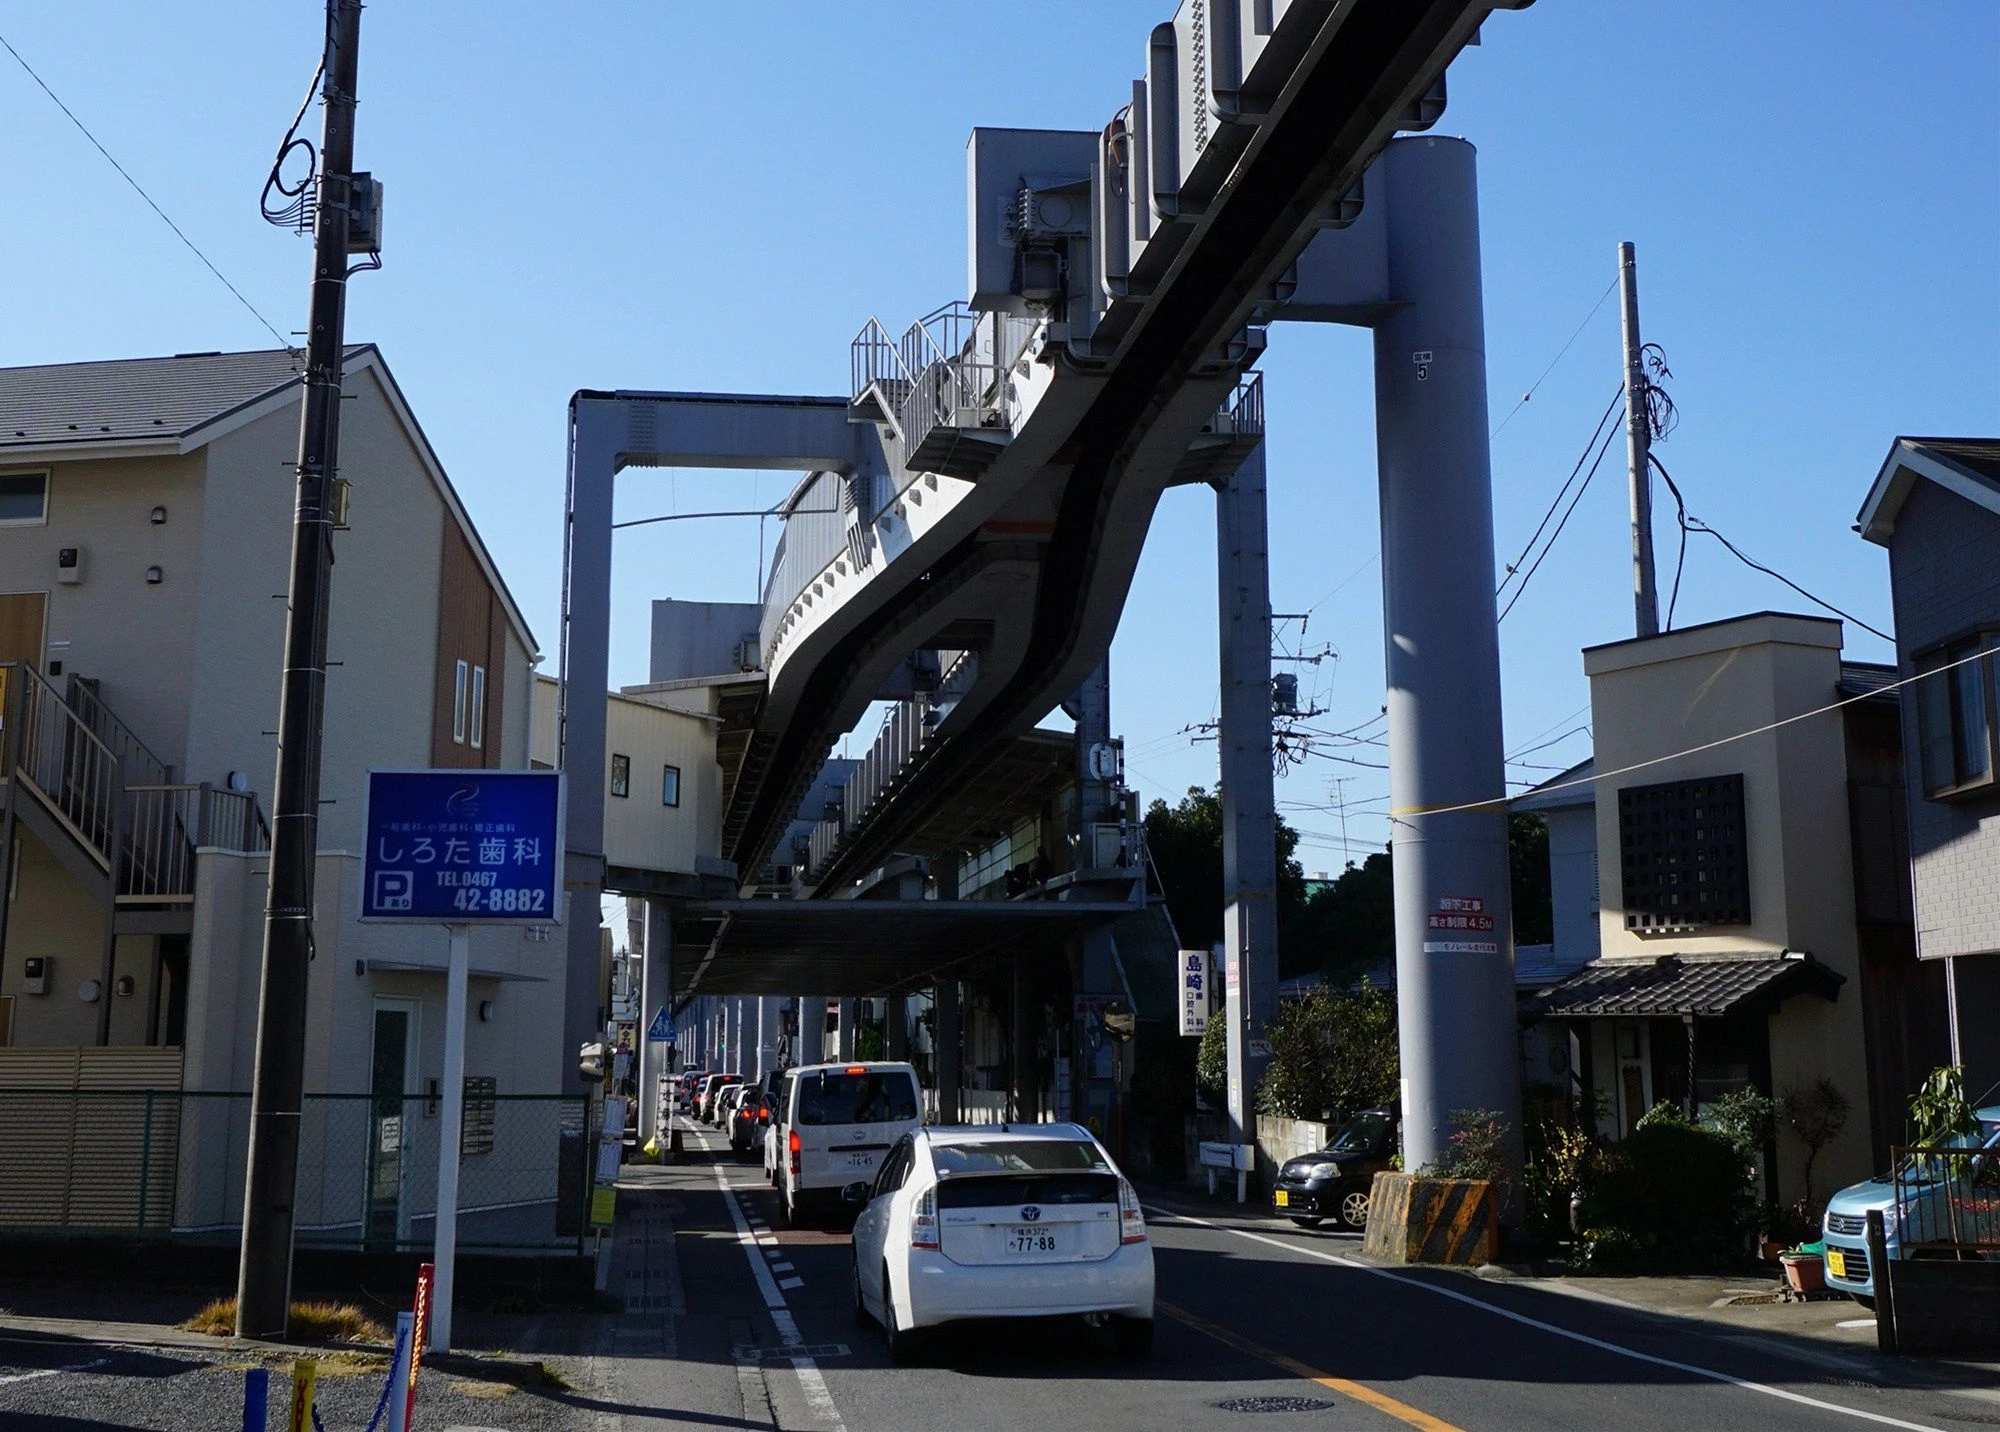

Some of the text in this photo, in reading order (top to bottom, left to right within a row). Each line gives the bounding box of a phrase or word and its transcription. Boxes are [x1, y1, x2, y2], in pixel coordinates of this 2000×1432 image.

[1418, 363, 1427, 379] 5
[379, 836, 542, 866] しろた歯科
[436, 871, 497, 887] TEL.0467
[377, 874, 408, 907] P
[453, 888, 546, 911] 42-8882
[1017, 1237, 1055, 1251] 77-88
